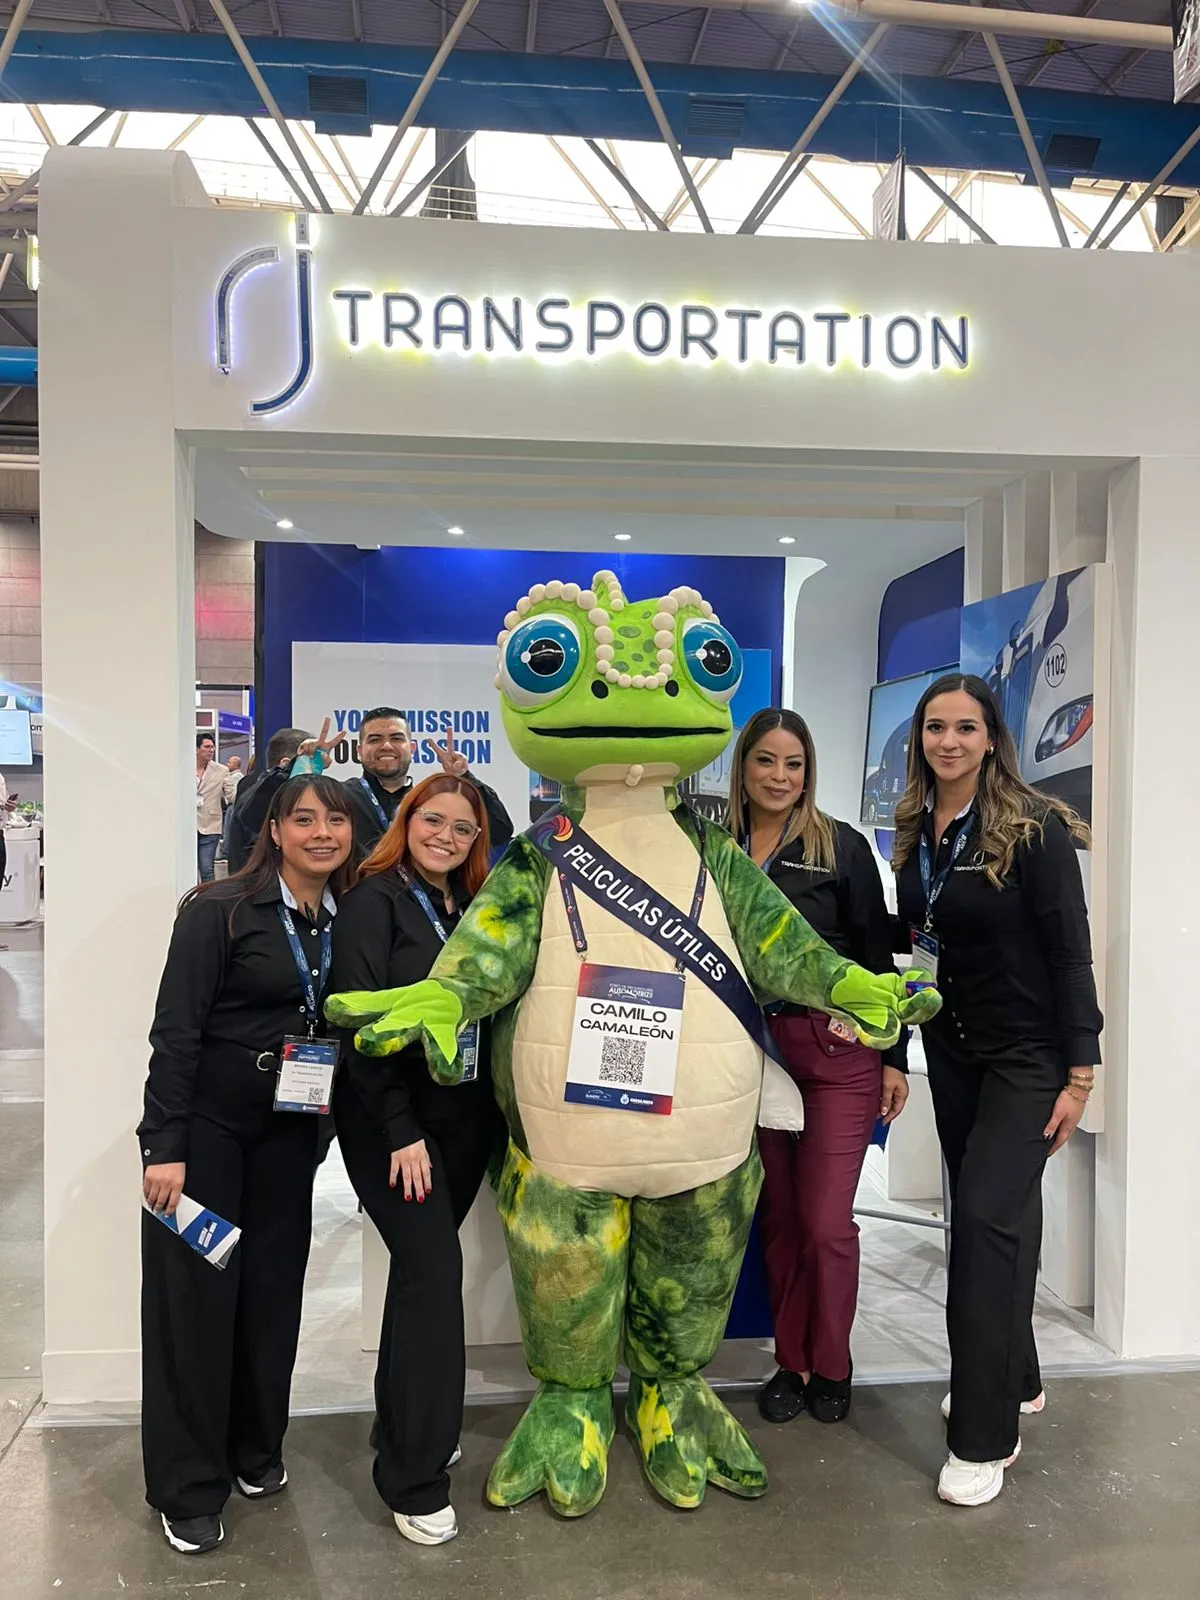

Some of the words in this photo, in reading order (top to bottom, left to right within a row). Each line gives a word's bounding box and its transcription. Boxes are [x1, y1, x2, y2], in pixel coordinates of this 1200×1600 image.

[332, 289, 970, 370] TRANSPORTATION
[1045, 653, 1066, 678] 1102
[562, 843, 663, 928] PELICULAS
[659, 917, 728, 983] ÚTILES
[590, 1002, 667, 1024] CAMILO
[580, 1018, 674, 1041] CAMALEÓN
